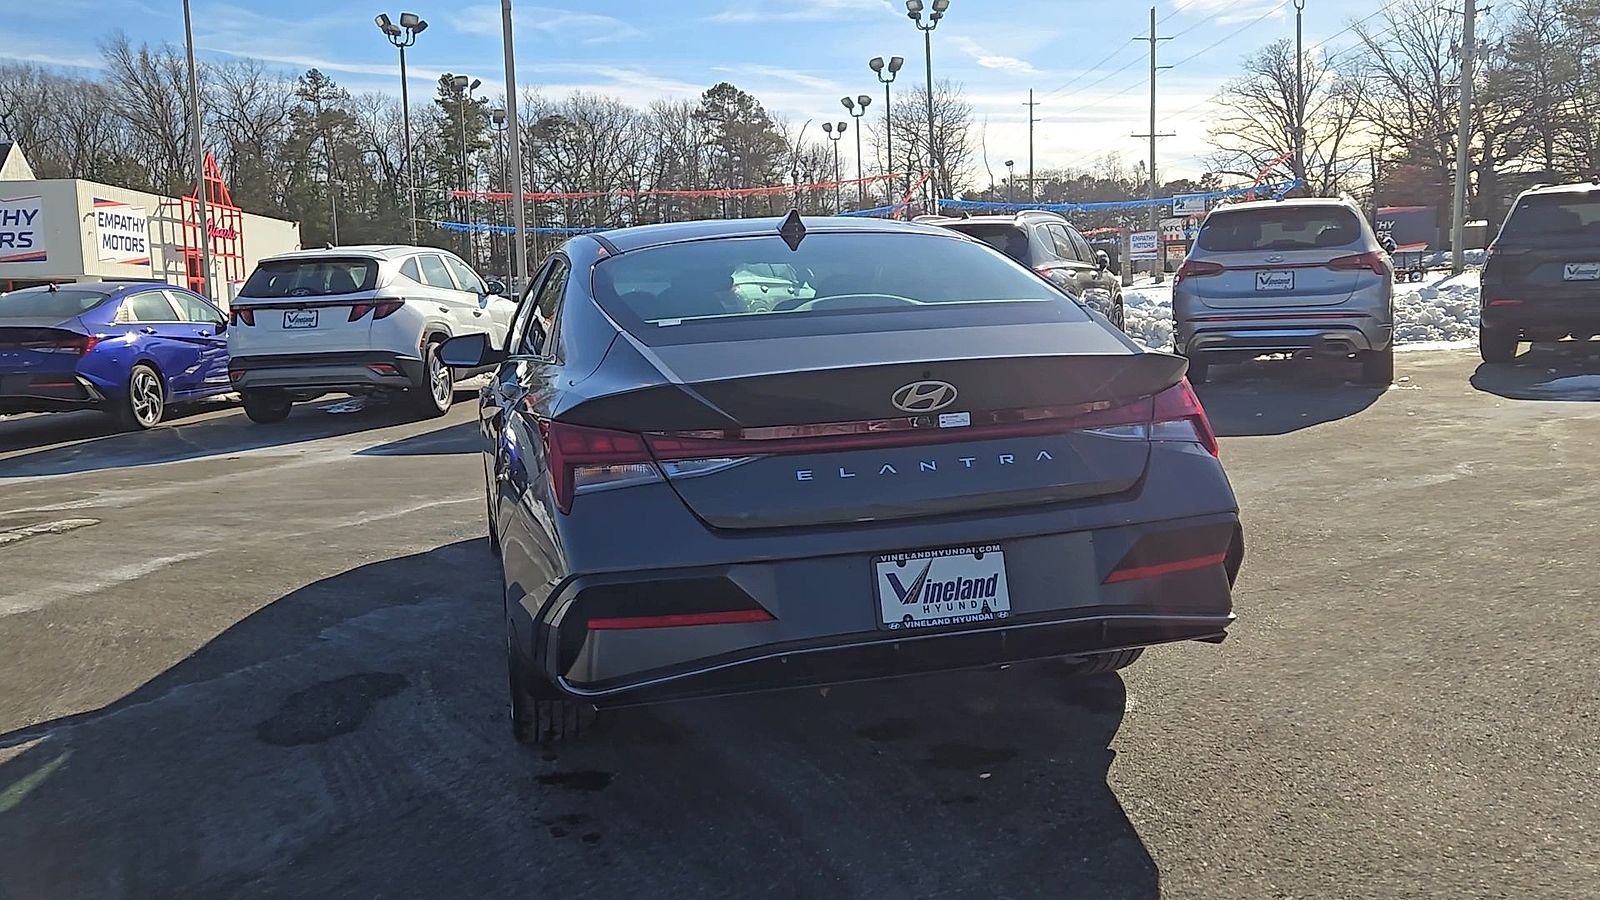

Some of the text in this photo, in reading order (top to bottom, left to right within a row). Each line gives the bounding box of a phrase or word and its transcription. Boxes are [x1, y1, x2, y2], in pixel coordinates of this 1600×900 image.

[0, 209, 39, 226] HY
[98, 211, 146, 233] EMPATHY
[102, 233, 145, 253] MOTORS
[796, 450, 1053, 481] ELANTRA
[880, 544, 1001, 562] VINELANDHYUNDAI.COM
[885, 557, 999, 606] Vineland
[922, 598, 998, 614] HYUNDAI
[903, 613, 994, 629] VINELAND HYUNDAI
